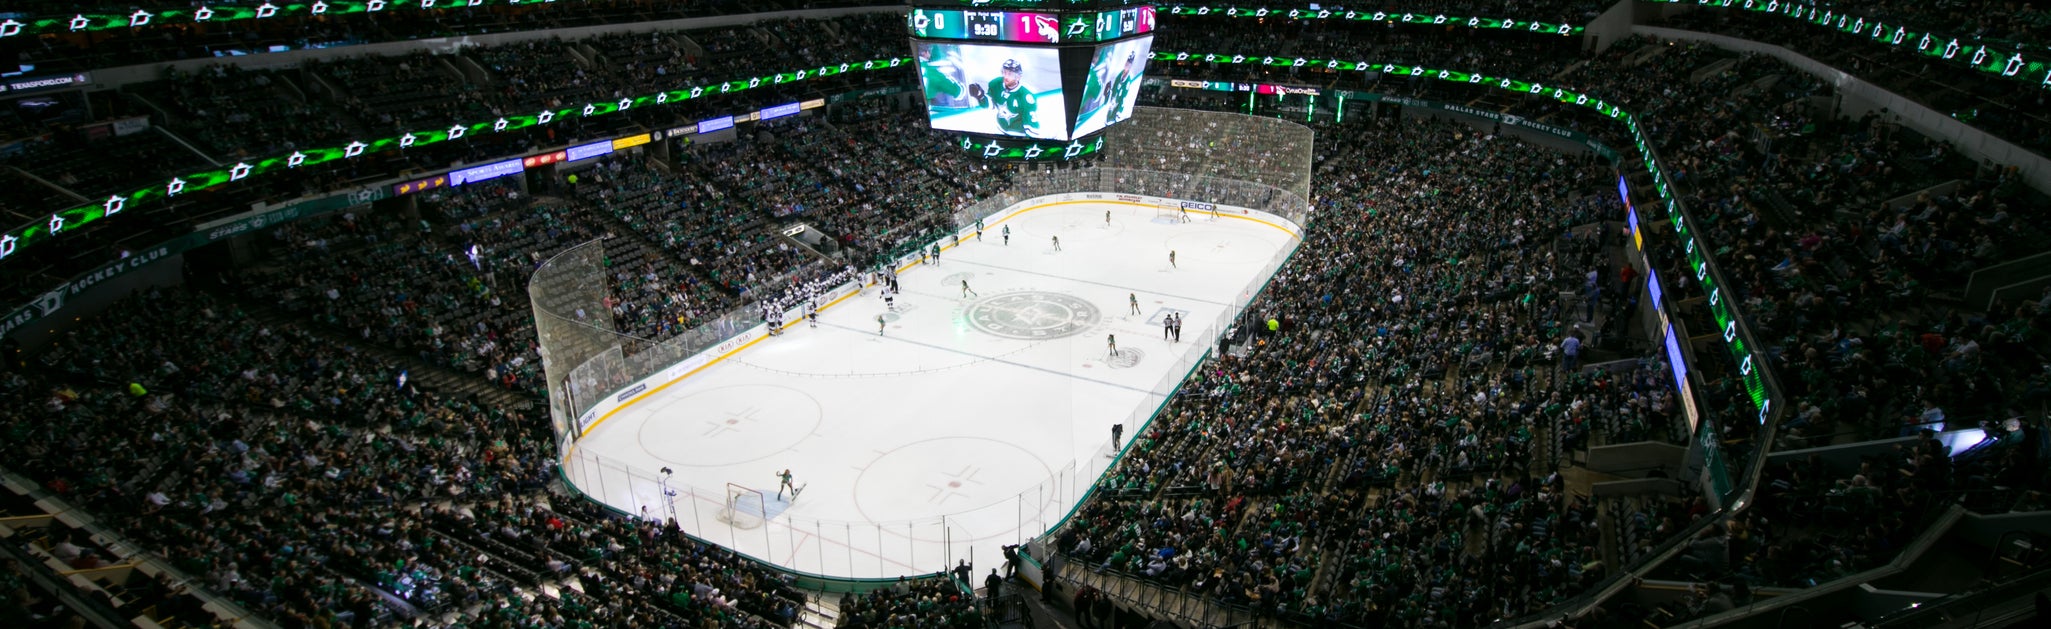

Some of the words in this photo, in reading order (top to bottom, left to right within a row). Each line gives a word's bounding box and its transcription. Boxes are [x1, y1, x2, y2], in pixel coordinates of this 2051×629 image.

[934, 13, 944, 29] 0
[1021, 16, 1030, 33] 1
[974, 23, 997, 36] 9:30
[10, 77, 73, 90] TEXASFORD.COM
[1444, 104, 1474, 114] DALLAS
[1476, 107, 1499, 119] STARS
[1522, 120, 1550, 132] HOCKEY
[1552, 127, 1572, 137] CLUB
[1181, 201, 1213, 211] GEICO
[71, 263, 125, 294] HOCKEY
[130, 248, 168, 267] CLUB
[580, 411, 596, 428] LIGHT
